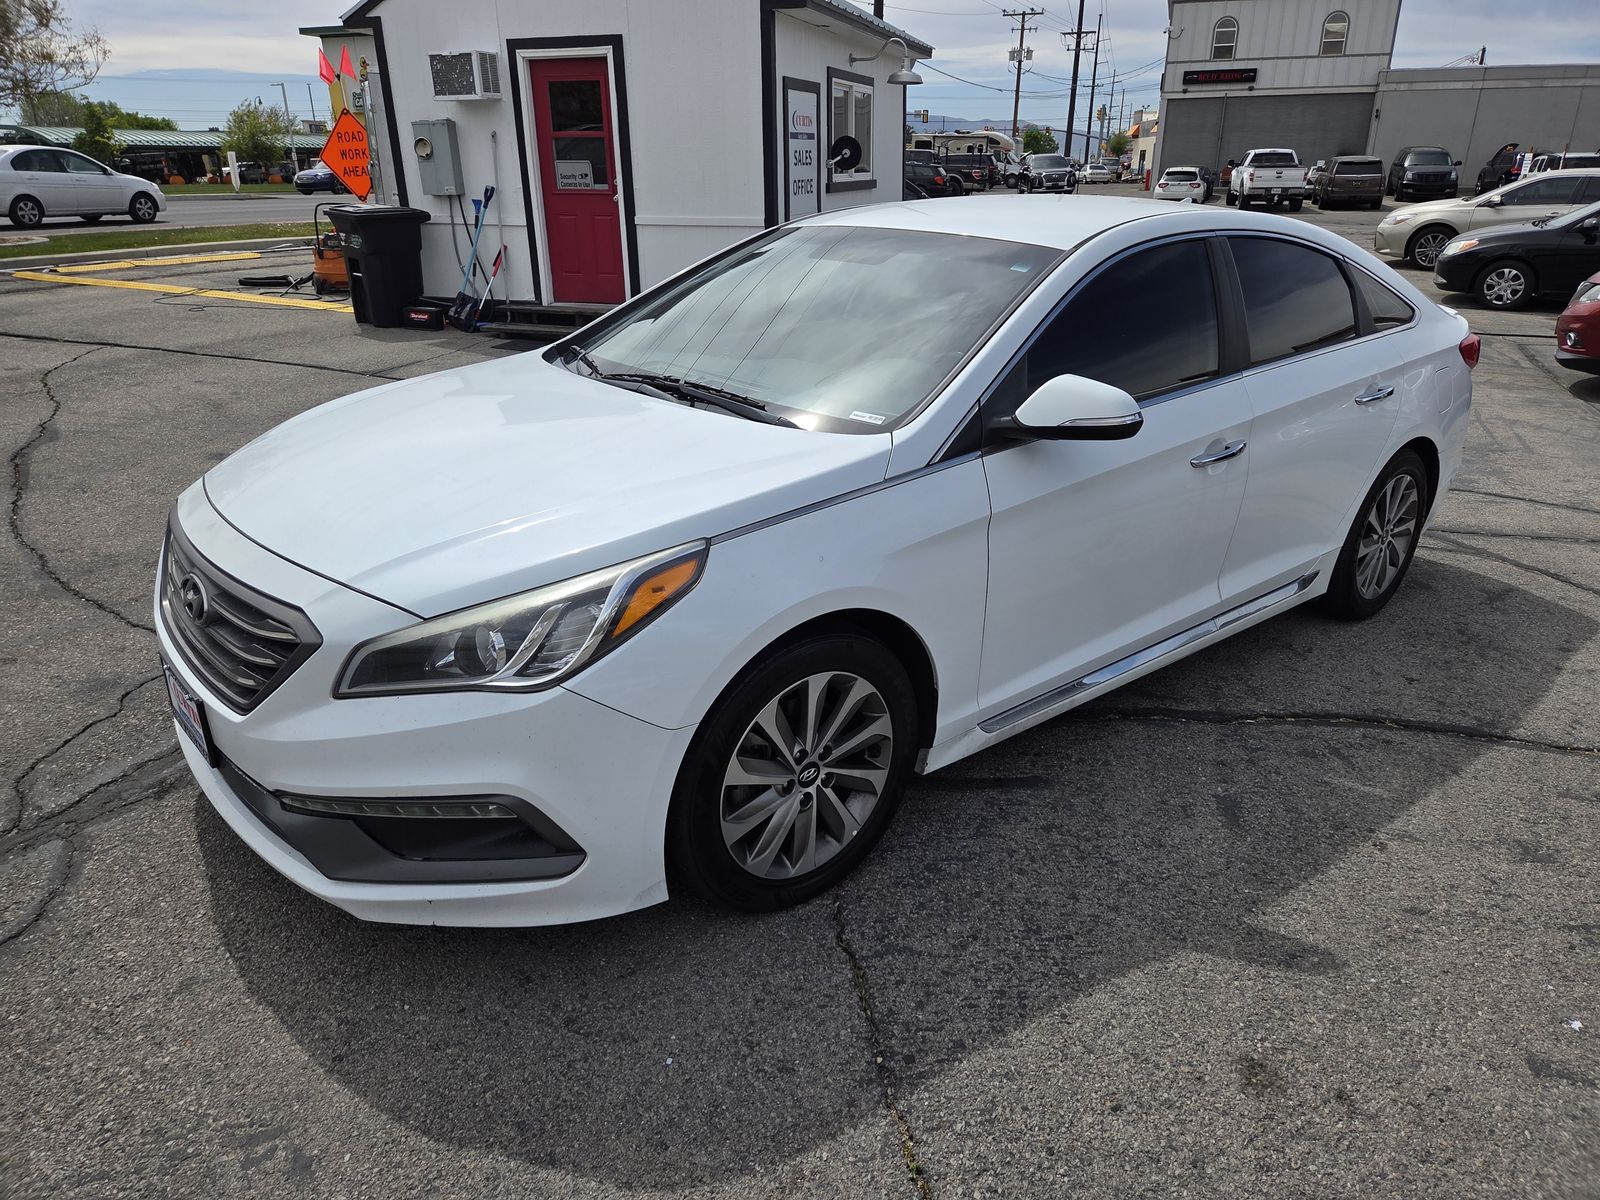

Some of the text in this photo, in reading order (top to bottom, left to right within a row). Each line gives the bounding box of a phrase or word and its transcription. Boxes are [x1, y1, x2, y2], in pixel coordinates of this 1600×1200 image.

[337, 131, 364, 143] ROAD
[340, 149, 369, 160] WORK
[794, 150, 813, 166] SALES
[343, 165, 370, 177] AHEA
[793, 179, 814, 196] OFFICE
